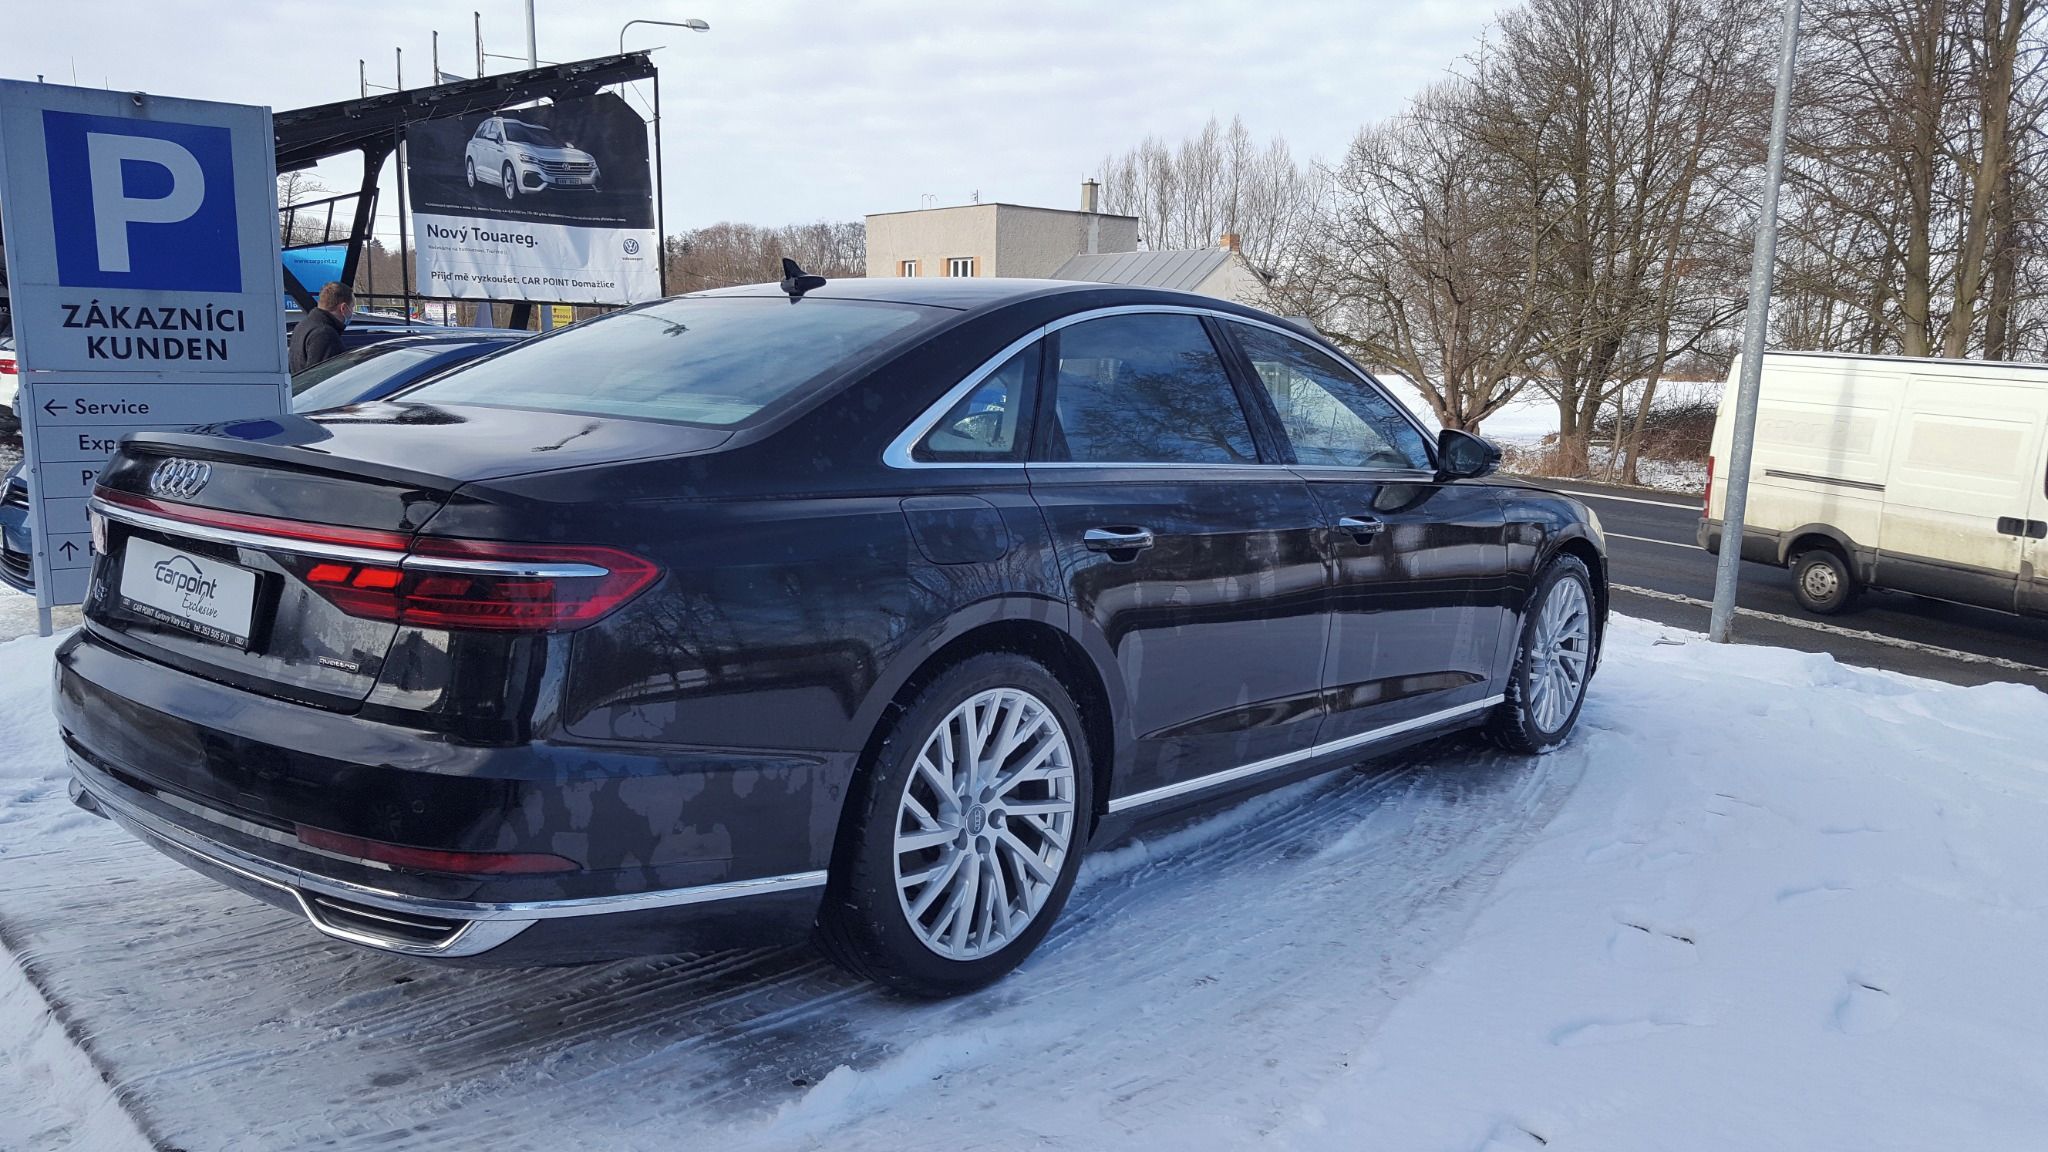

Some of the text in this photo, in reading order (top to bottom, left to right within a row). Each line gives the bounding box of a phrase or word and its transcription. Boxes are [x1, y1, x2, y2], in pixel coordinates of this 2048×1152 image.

[87, 131, 206, 273] P
[426, 223, 539, 248] Nový Touareg.
[454, 273, 469, 281] mě
[471, 273, 520, 285] vyzkoušet.
[521, 276, 540, 285] CAR
[542, 277, 569, 287] POINT
[571, 279, 615, 289] Domažlice
[60, 299, 245, 332] ZÁKAZNÍCI
[87, 335, 228, 360] KUNDEN
[75, 398, 149, 416] Service
[79, 434, 115, 454] Exp
[155, 565, 217, 599] carpoint
[181, 593, 219, 619] Exclusive
[318, 658, 357, 670] quattro
